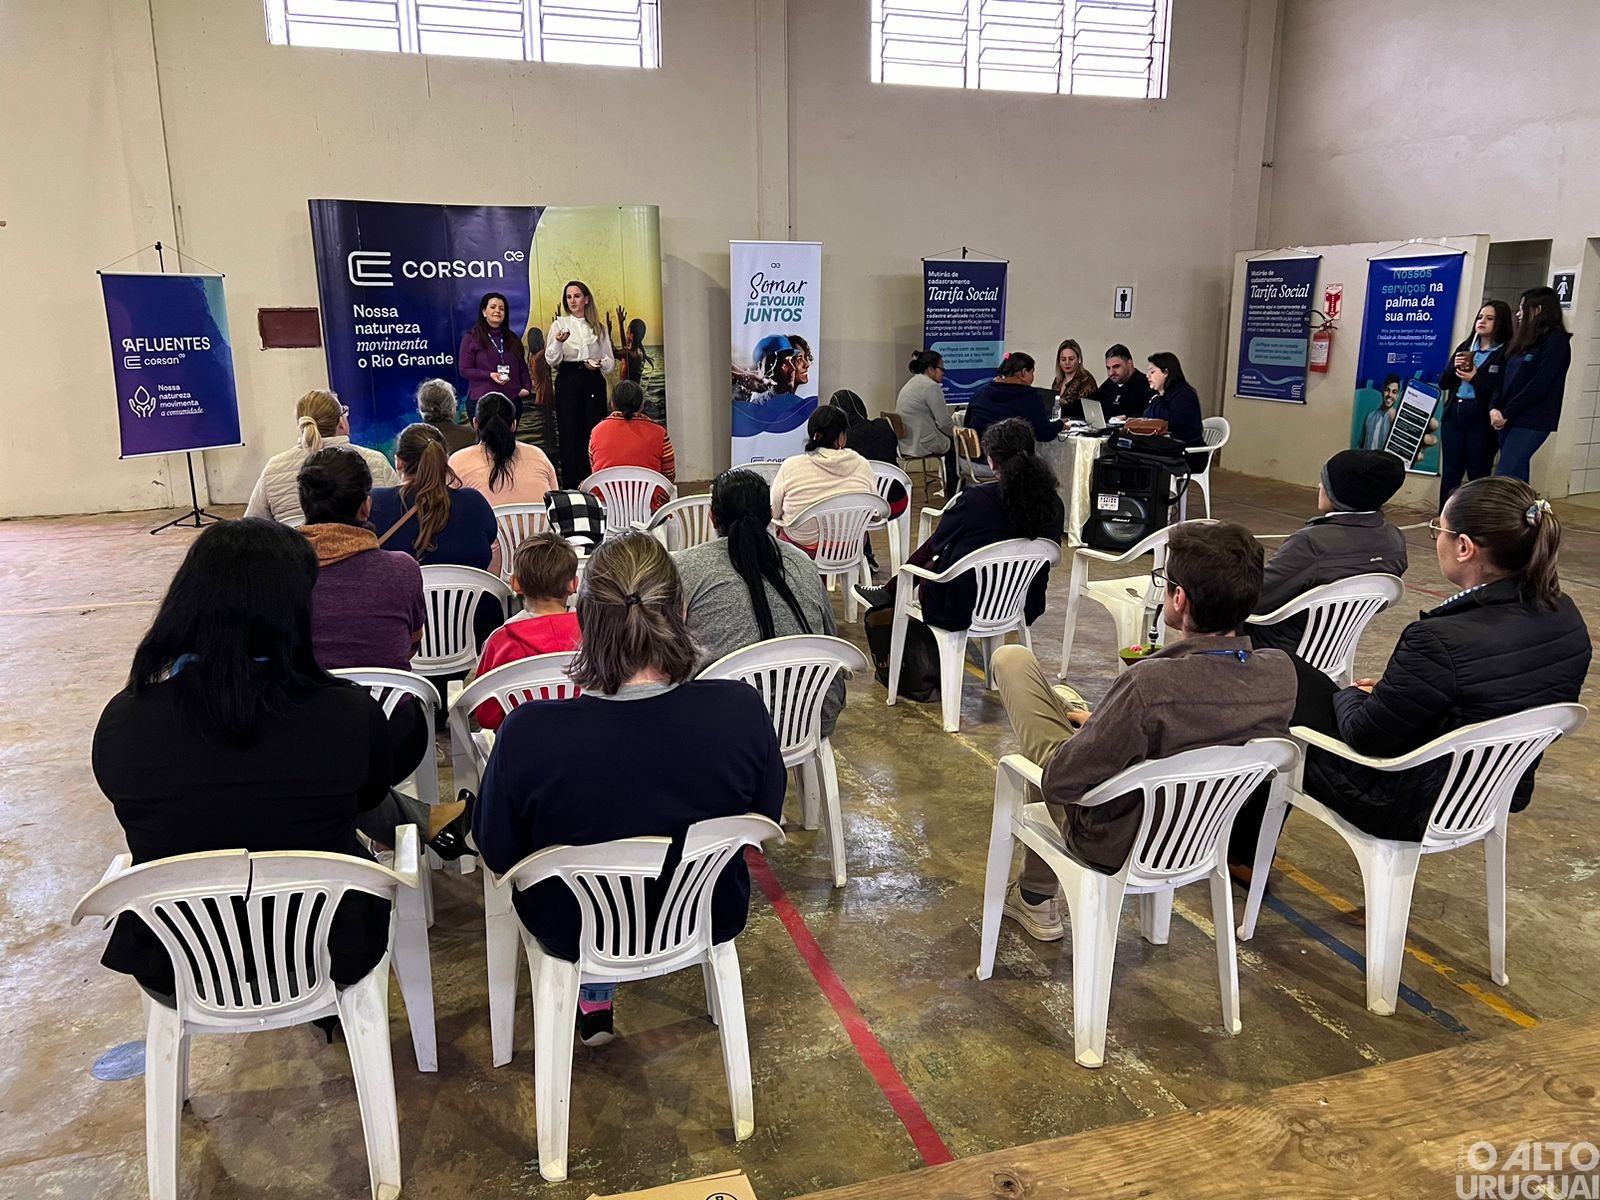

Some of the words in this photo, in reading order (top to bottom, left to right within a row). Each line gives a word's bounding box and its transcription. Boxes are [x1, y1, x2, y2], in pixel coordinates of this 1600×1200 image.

[1393, 269, 1432, 280] Nossos
[750, 272, 808, 300] Somar
[1250, 284, 1277, 302] Tarifa
[1279, 283, 1310, 298] Social
[1381, 282, 1426, 296] serviços
[1429, 281, 1444, 293] na
[760, 296, 805, 307] EVOLUIR
[928, 286, 963, 304] Tarifa
[966, 286, 999, 301] Social
[1385, 296, 1418, 310] palma
[1420, 295, 1435, 307] da
[353, 304, 398, 318] Nossa
[744, 308, 802, 324] JUNTOS
[1384, 311, 1404, 322] sua
[1405, 310, 1433, 322] mão.
[355, 323, 421, 334] natureza
[122, 336, 211, 352] AFLUENTES
[356, 338, 428, 352] movimenta
[358, 358, 367, 368] o
[372, 354, 394, 368] Rio
[398, 352, 454, 366] Grande
[160, 399, 199, 407] movimenta
